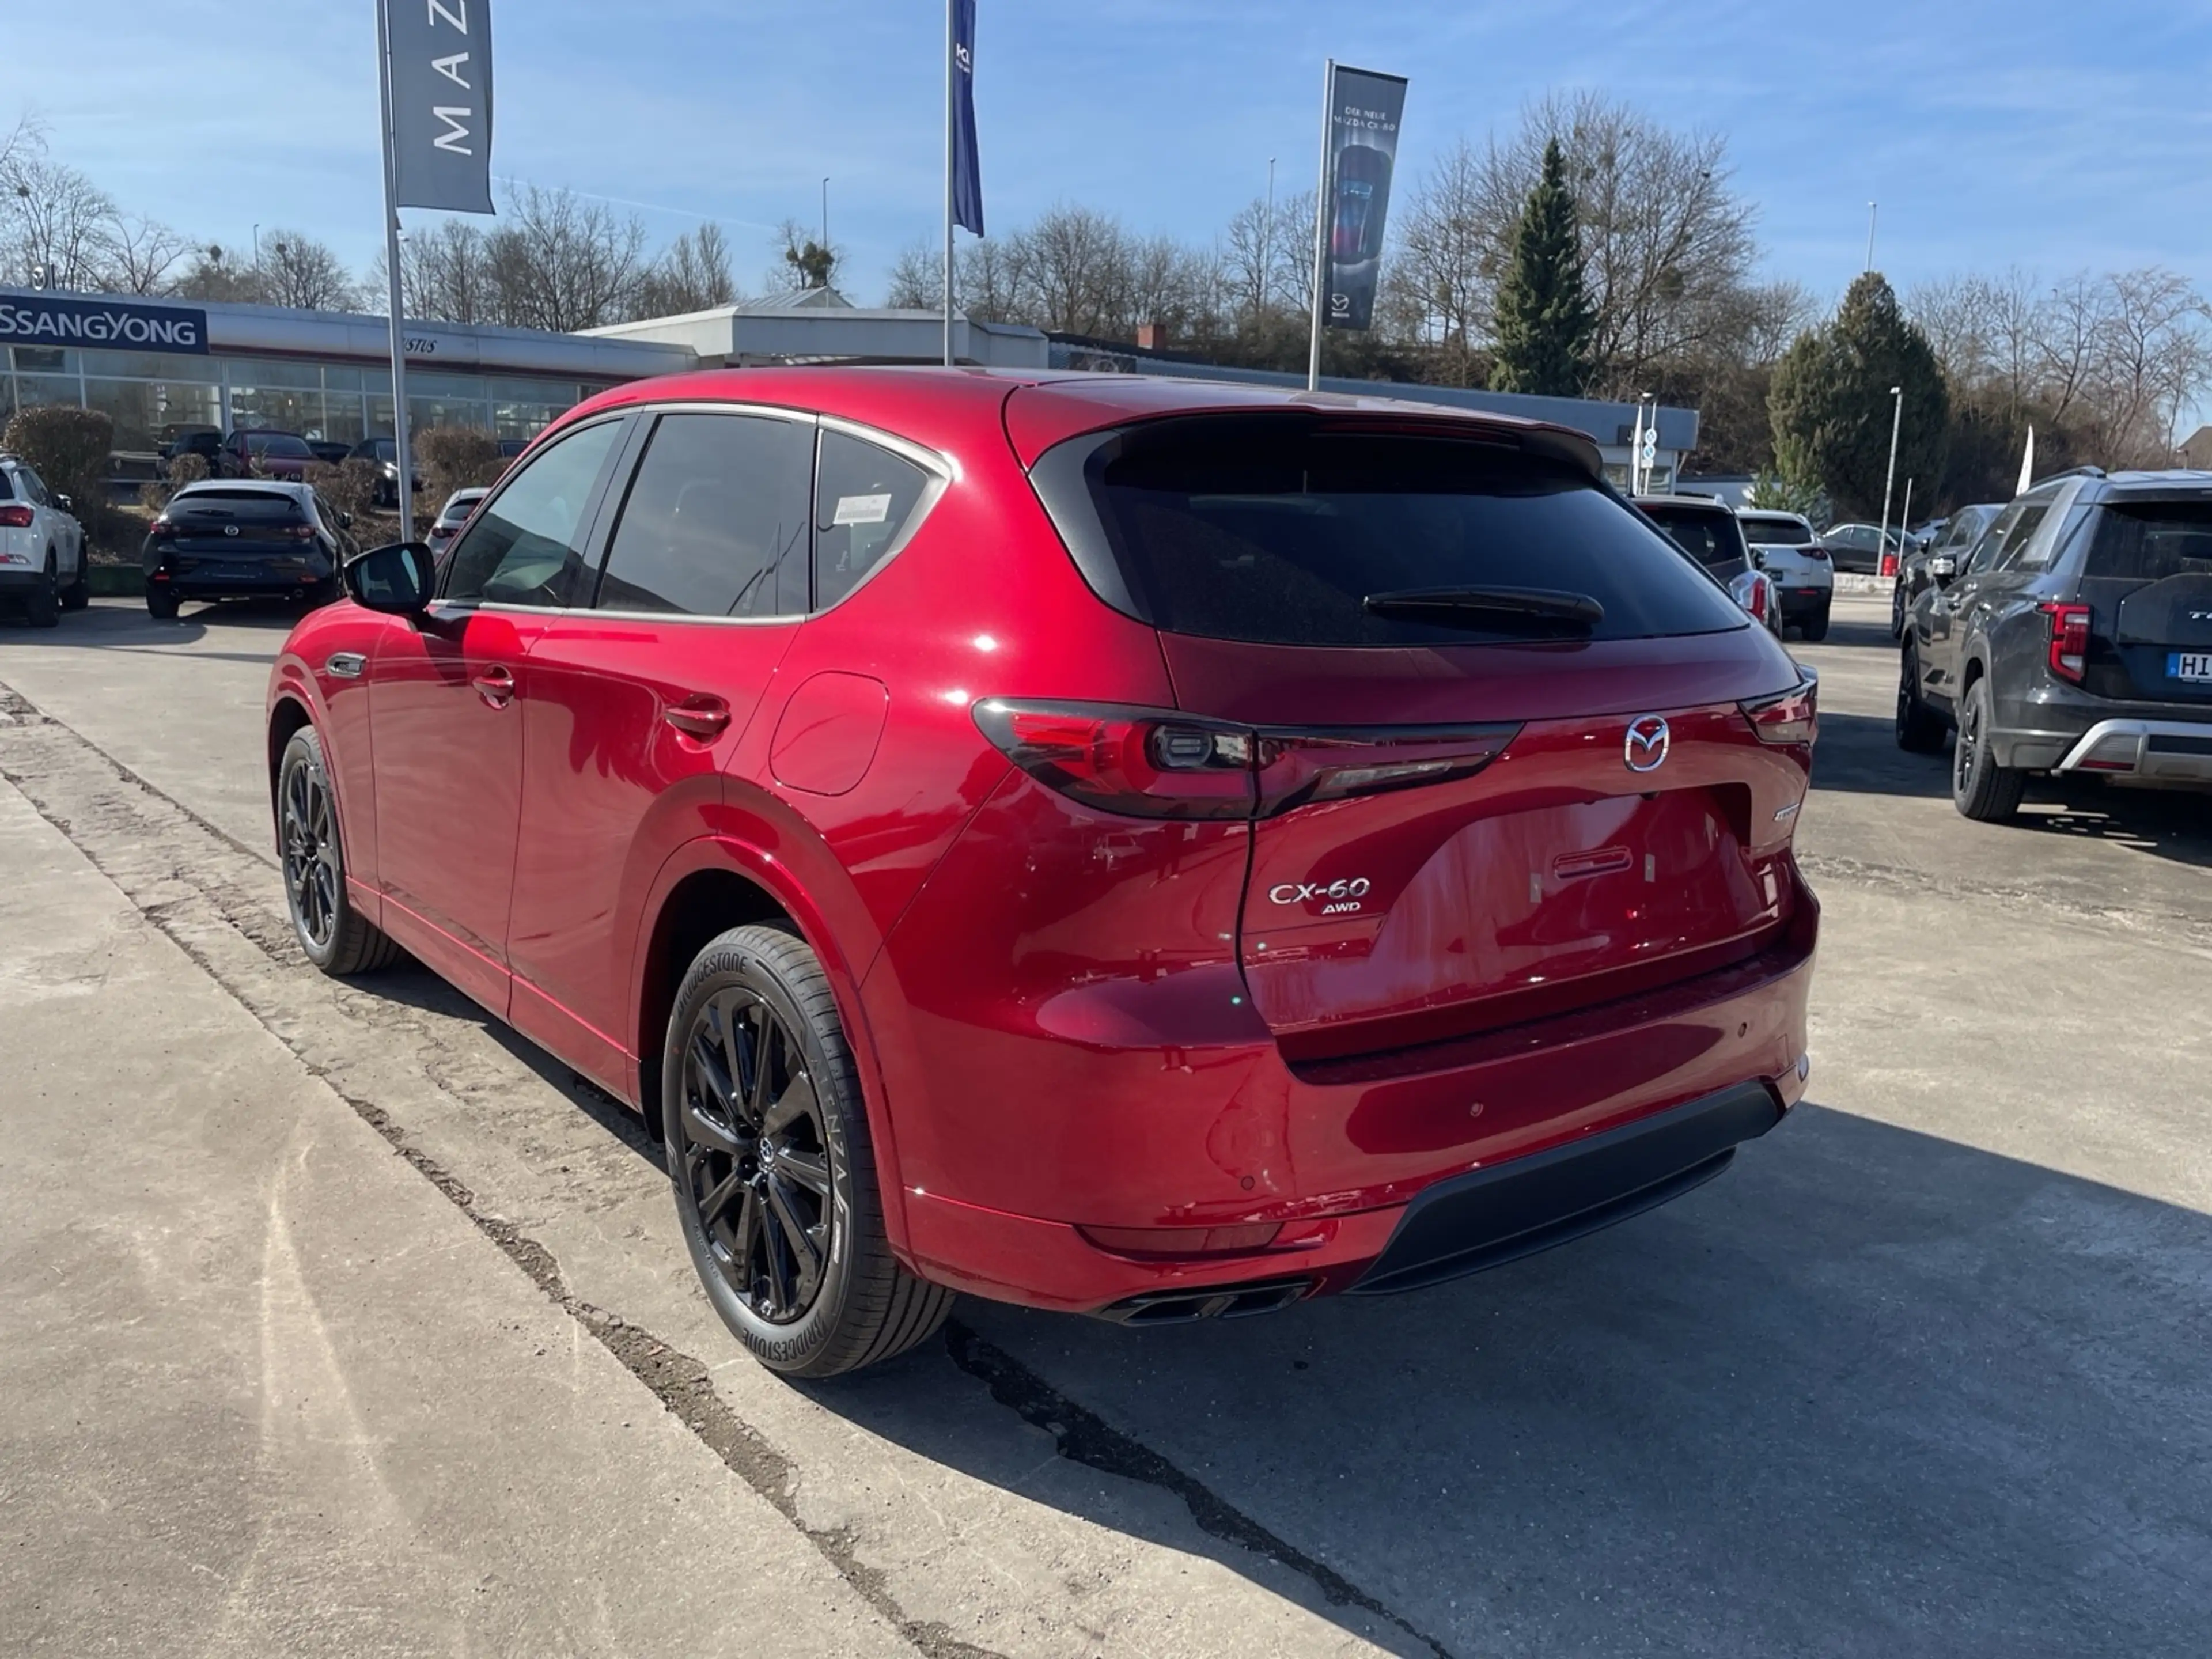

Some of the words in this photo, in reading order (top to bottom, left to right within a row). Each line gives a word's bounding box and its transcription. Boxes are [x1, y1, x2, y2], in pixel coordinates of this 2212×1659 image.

[427, 0, 472, 156] MAZ
[0, 304, 196, 345] SSANGYONG
[1269, 877, 1370, 904] CX-60
[1321, 902, 1361, 914] AWD
[677, 952, 748, 1020] BRIDGESTONE
[742, 1308, 829, 1362] BRIDGESTONE
